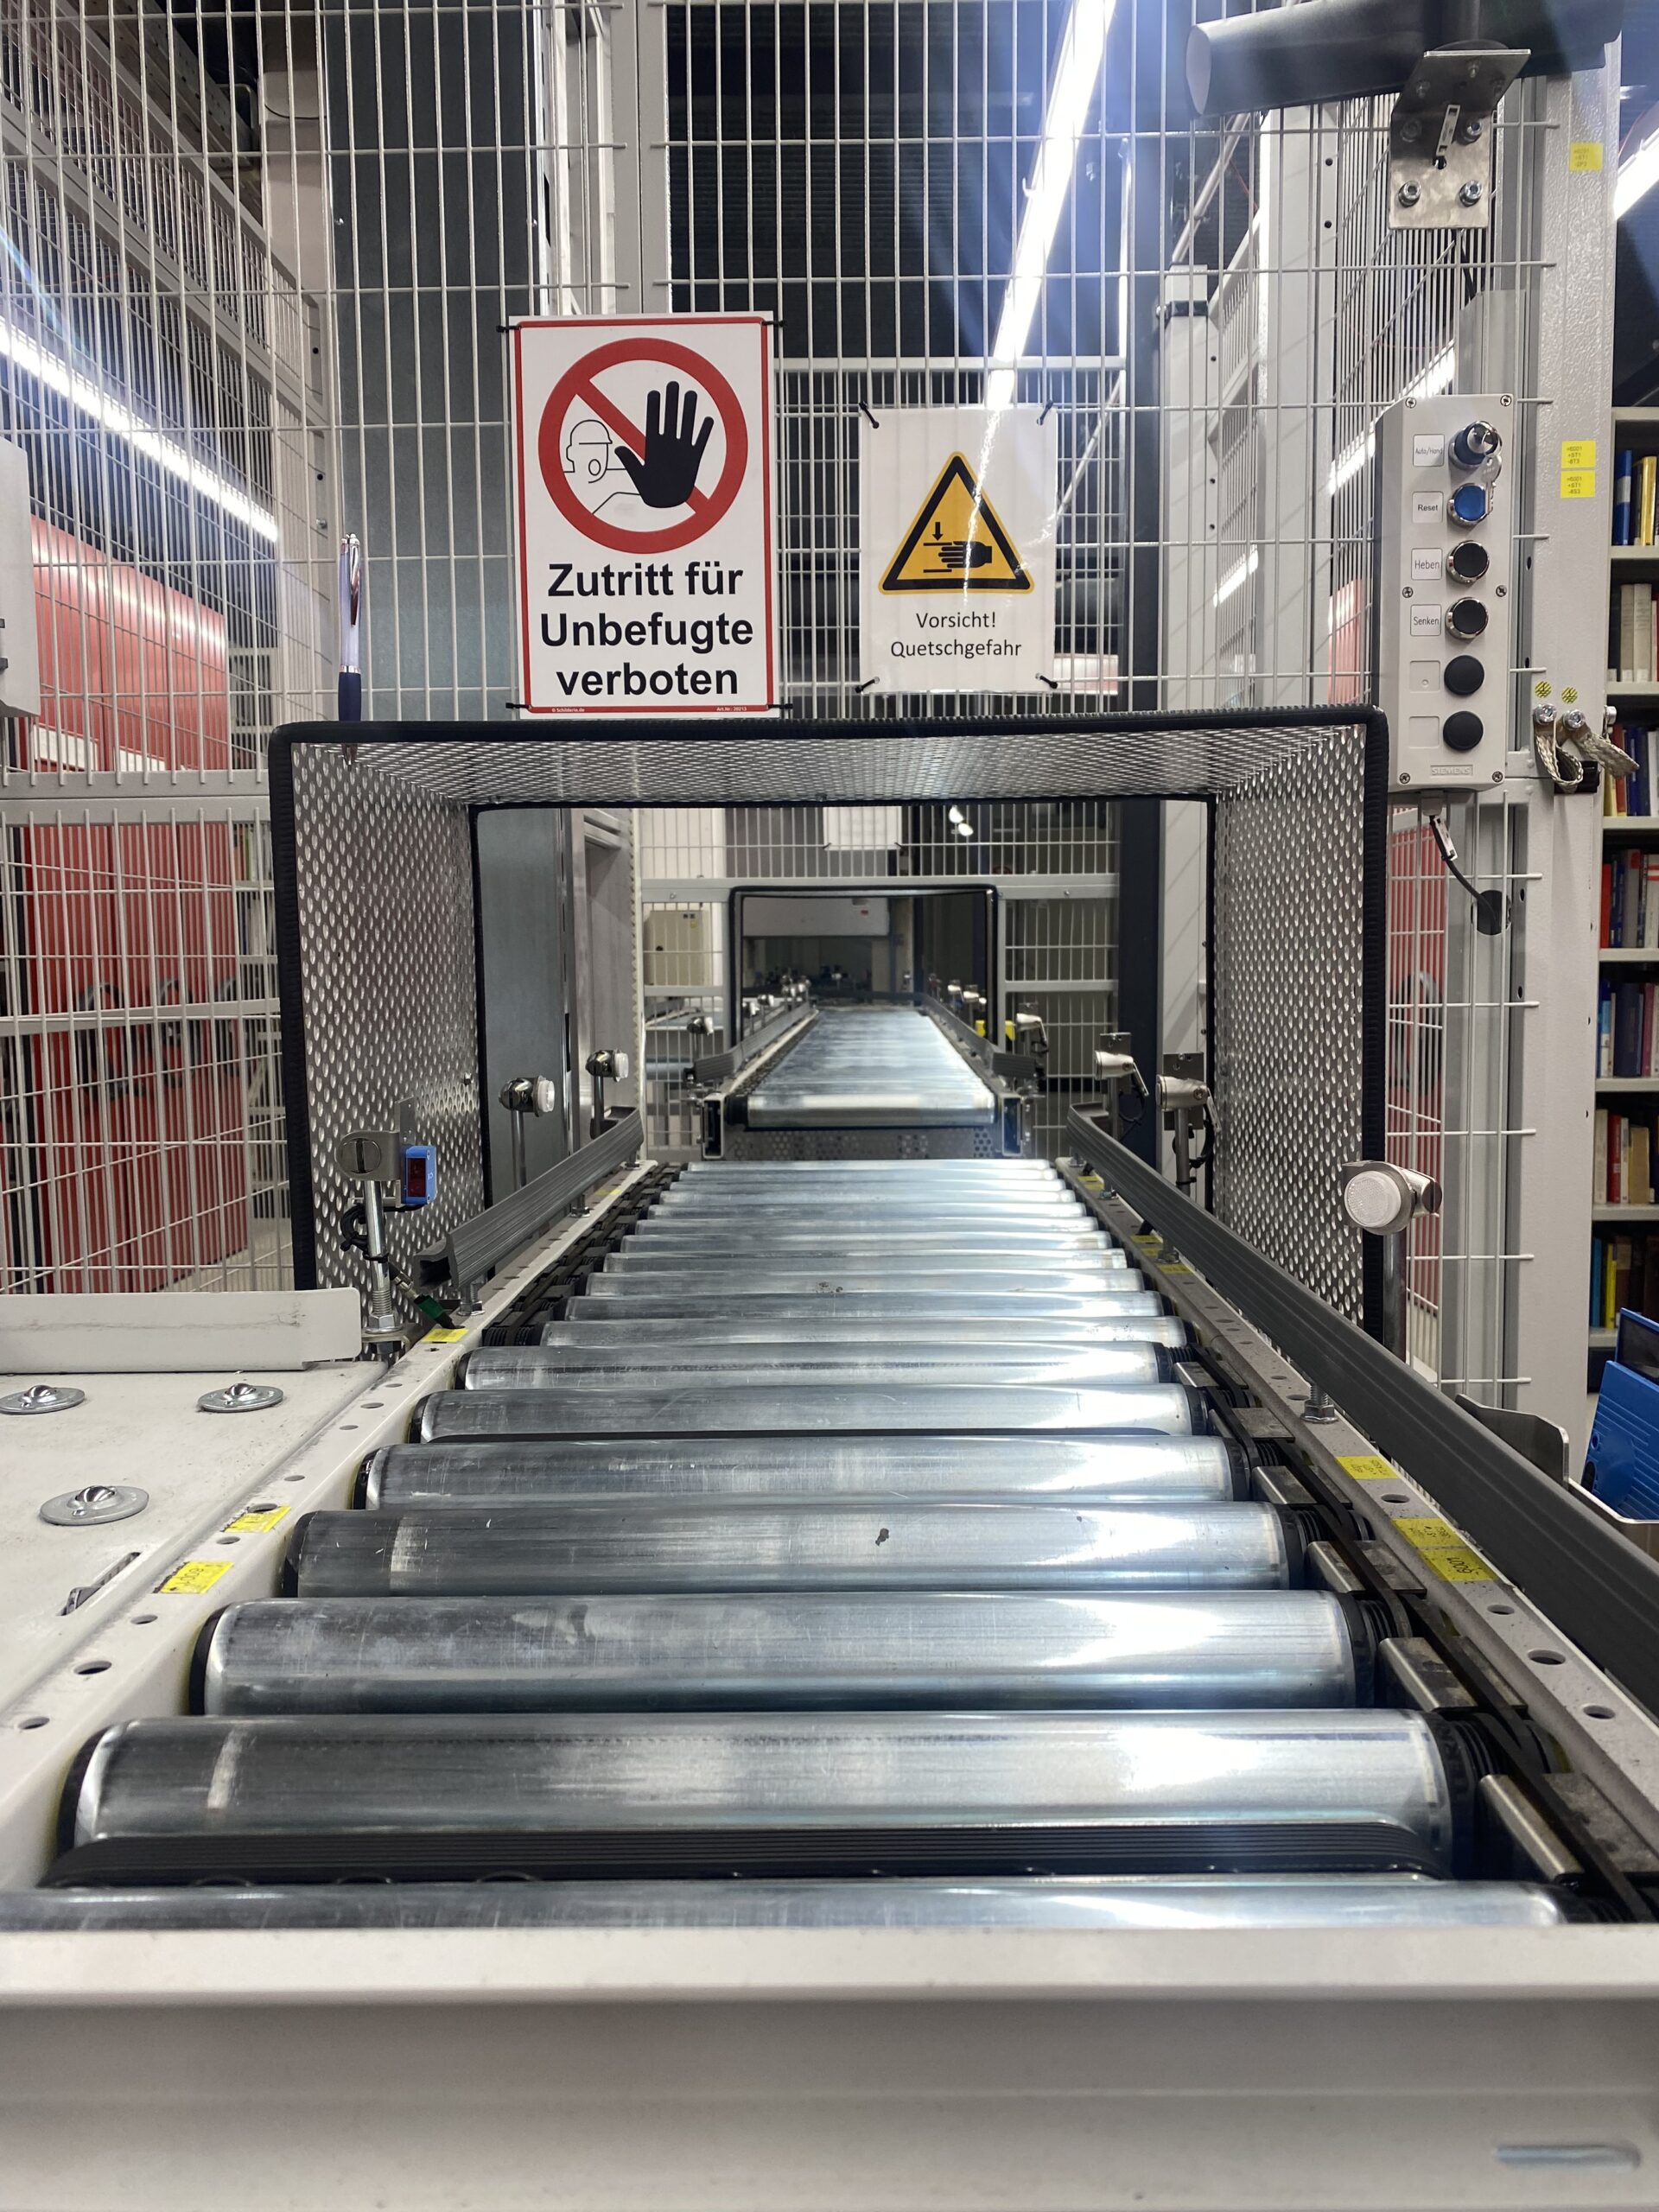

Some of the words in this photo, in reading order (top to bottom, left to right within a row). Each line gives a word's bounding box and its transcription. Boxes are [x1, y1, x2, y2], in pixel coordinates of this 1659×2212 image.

[1415, 448, 1443, 456] Auto/Hand
[1414, 559, 1440, 569] Heben
[548, 563, 674, 596] Zutritt
[684, 561, 743, 595] für
[916, 611, 995, 628] Vorsicht!
[1413, 616, 1440, 626] Senken
[540, 612, 753, 654] Unbefugte
[891, 639, 1022, 659] Quetschgefahr
[556, 662, 738, 696] verboten
[1431, 766, 1471, 776] SIEMENS
